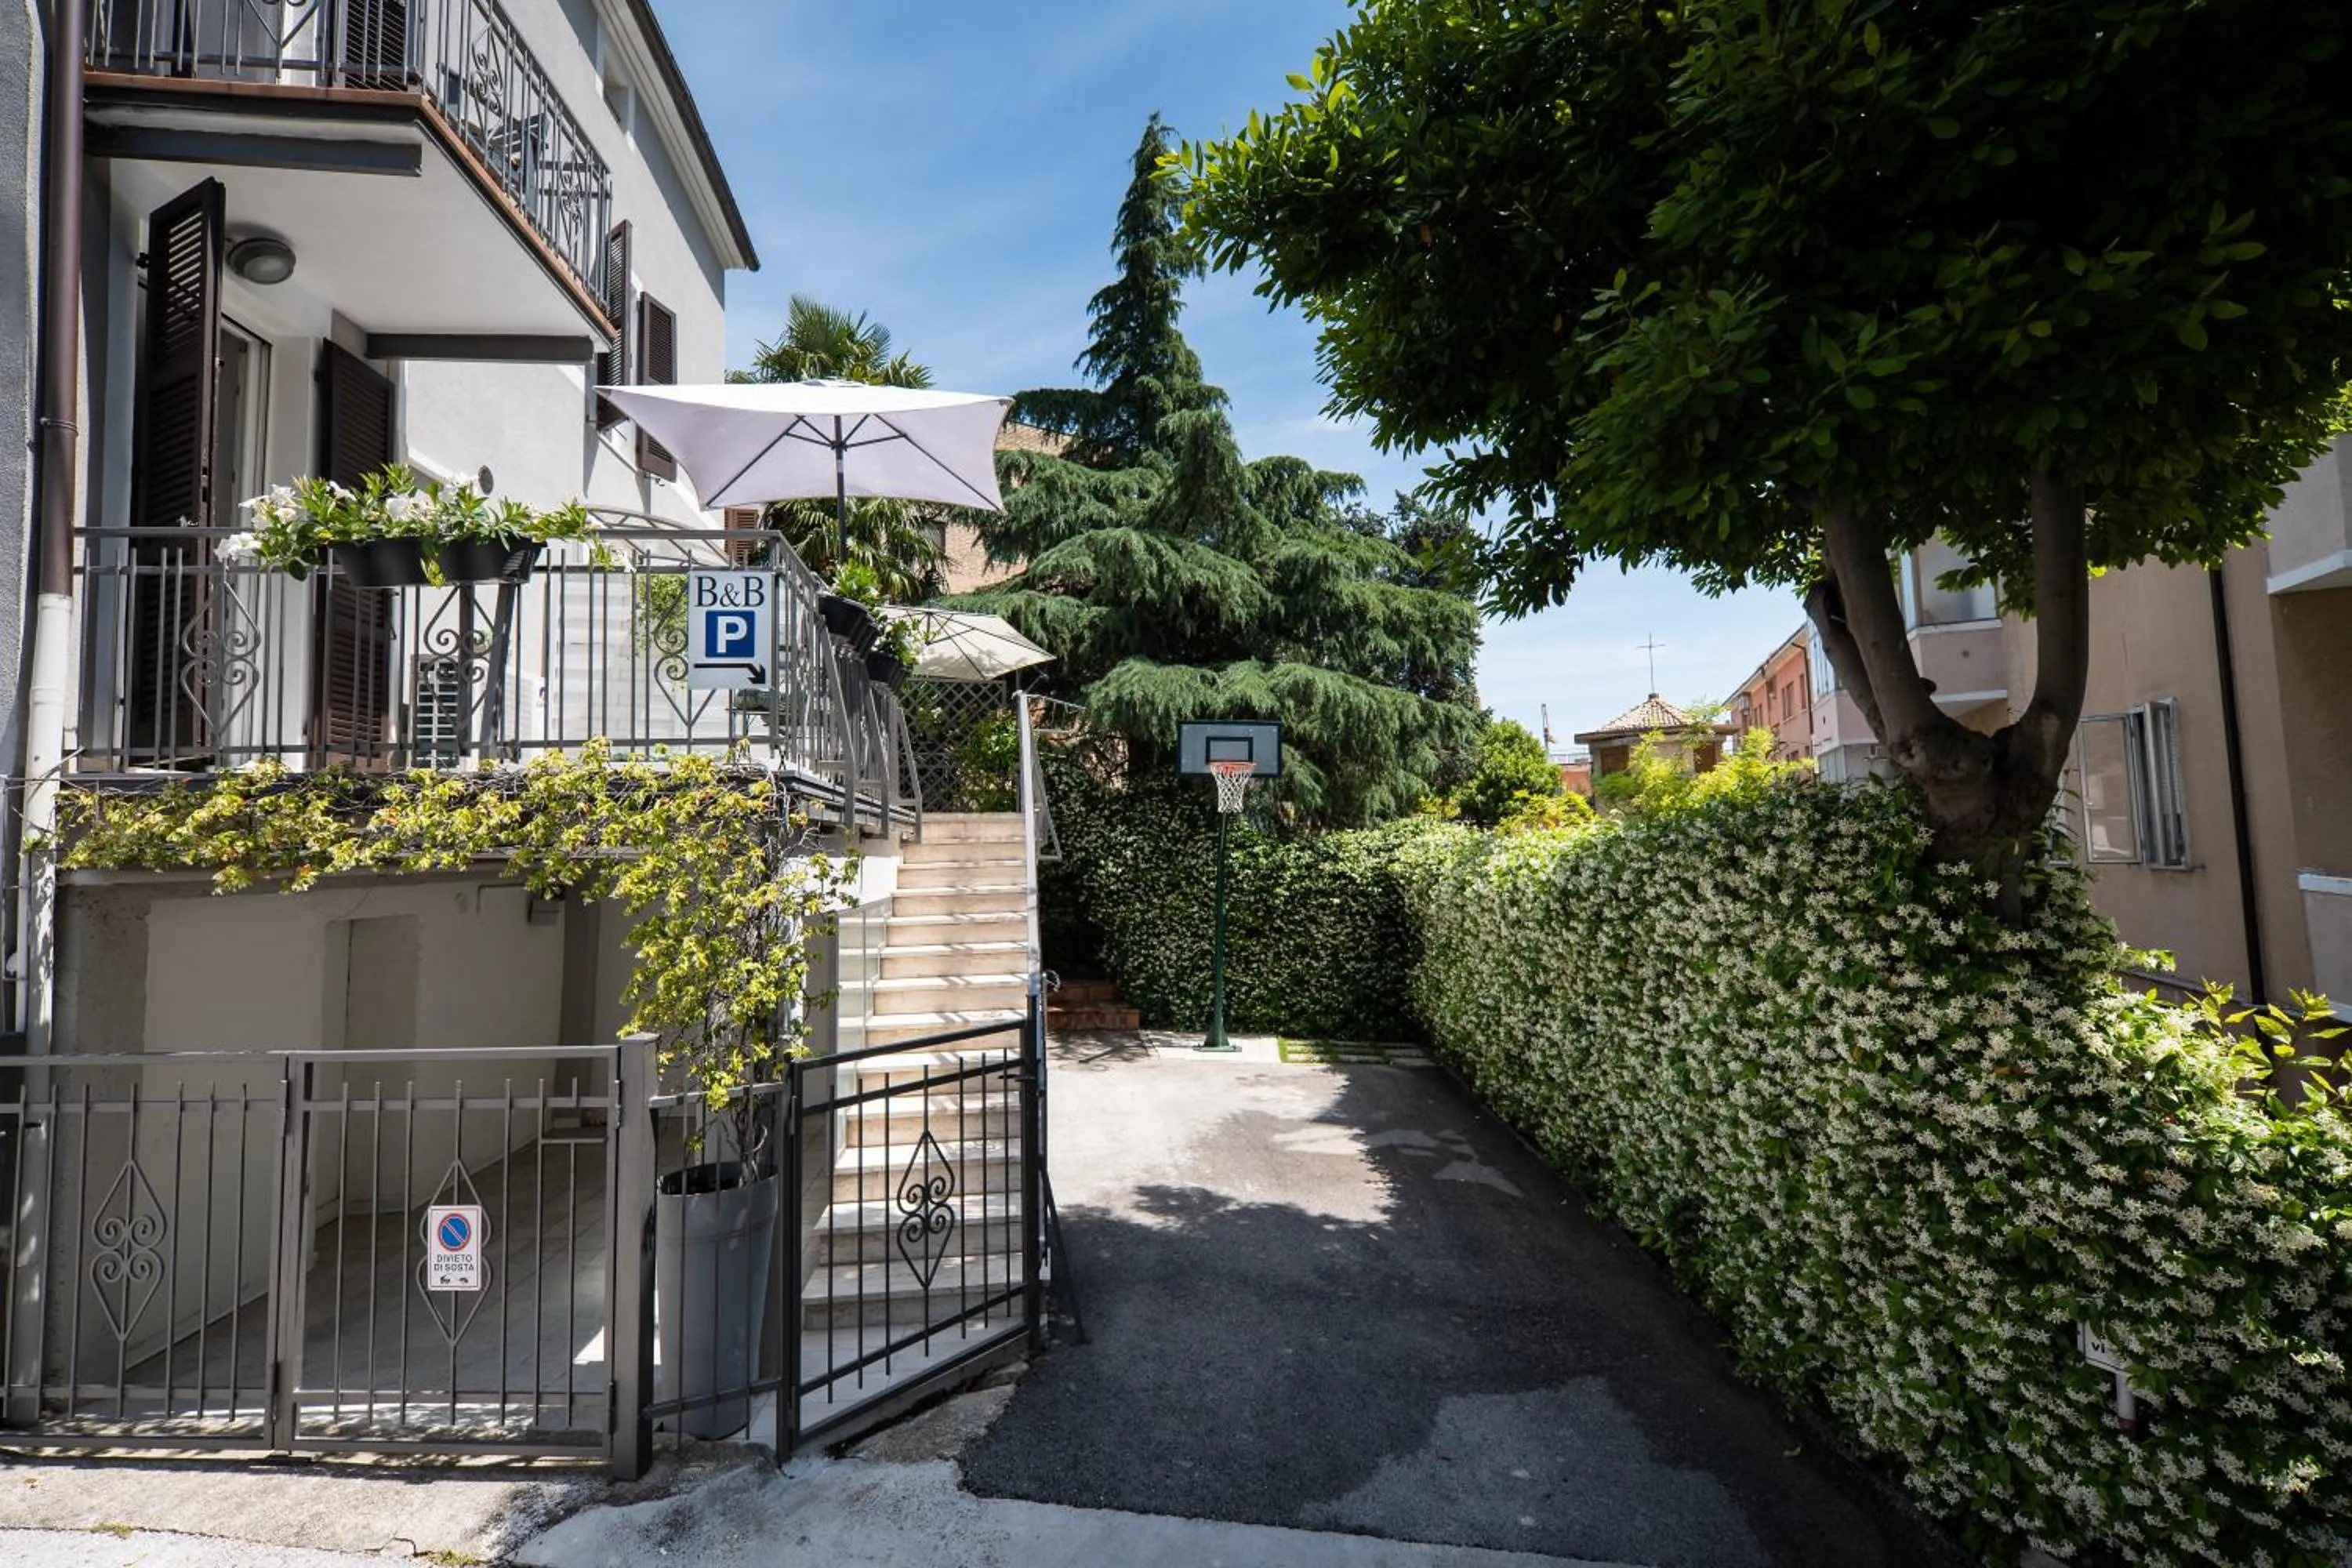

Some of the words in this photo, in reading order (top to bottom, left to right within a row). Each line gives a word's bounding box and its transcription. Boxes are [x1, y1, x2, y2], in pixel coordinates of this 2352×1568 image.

[694, 575, 765, 608] B&B
[717, 615, 747, 654] P
[437, 1254, 473, 1263] DIVIETO
